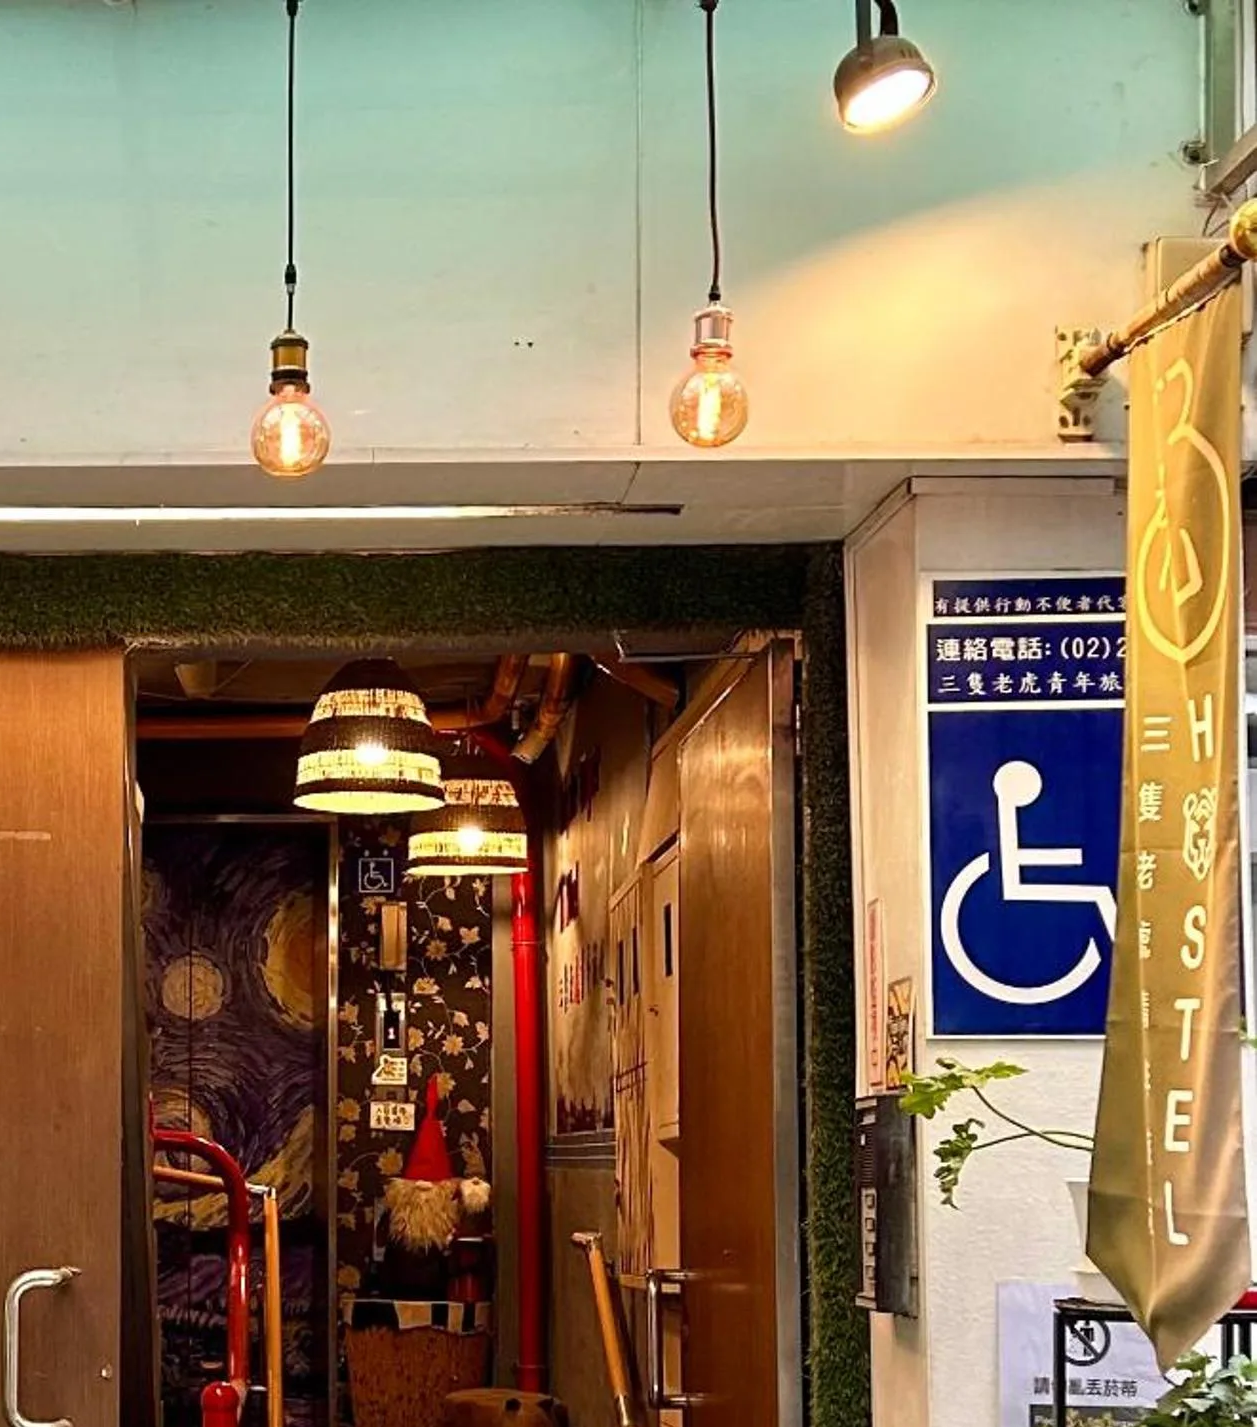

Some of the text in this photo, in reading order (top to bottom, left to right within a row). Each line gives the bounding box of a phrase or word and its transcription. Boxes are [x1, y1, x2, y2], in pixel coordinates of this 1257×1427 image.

[938, 671, 1124, 696] 三隻老虎青年旅
[1033, 1376, 1138, 1398] 請亂丟菸蒂
